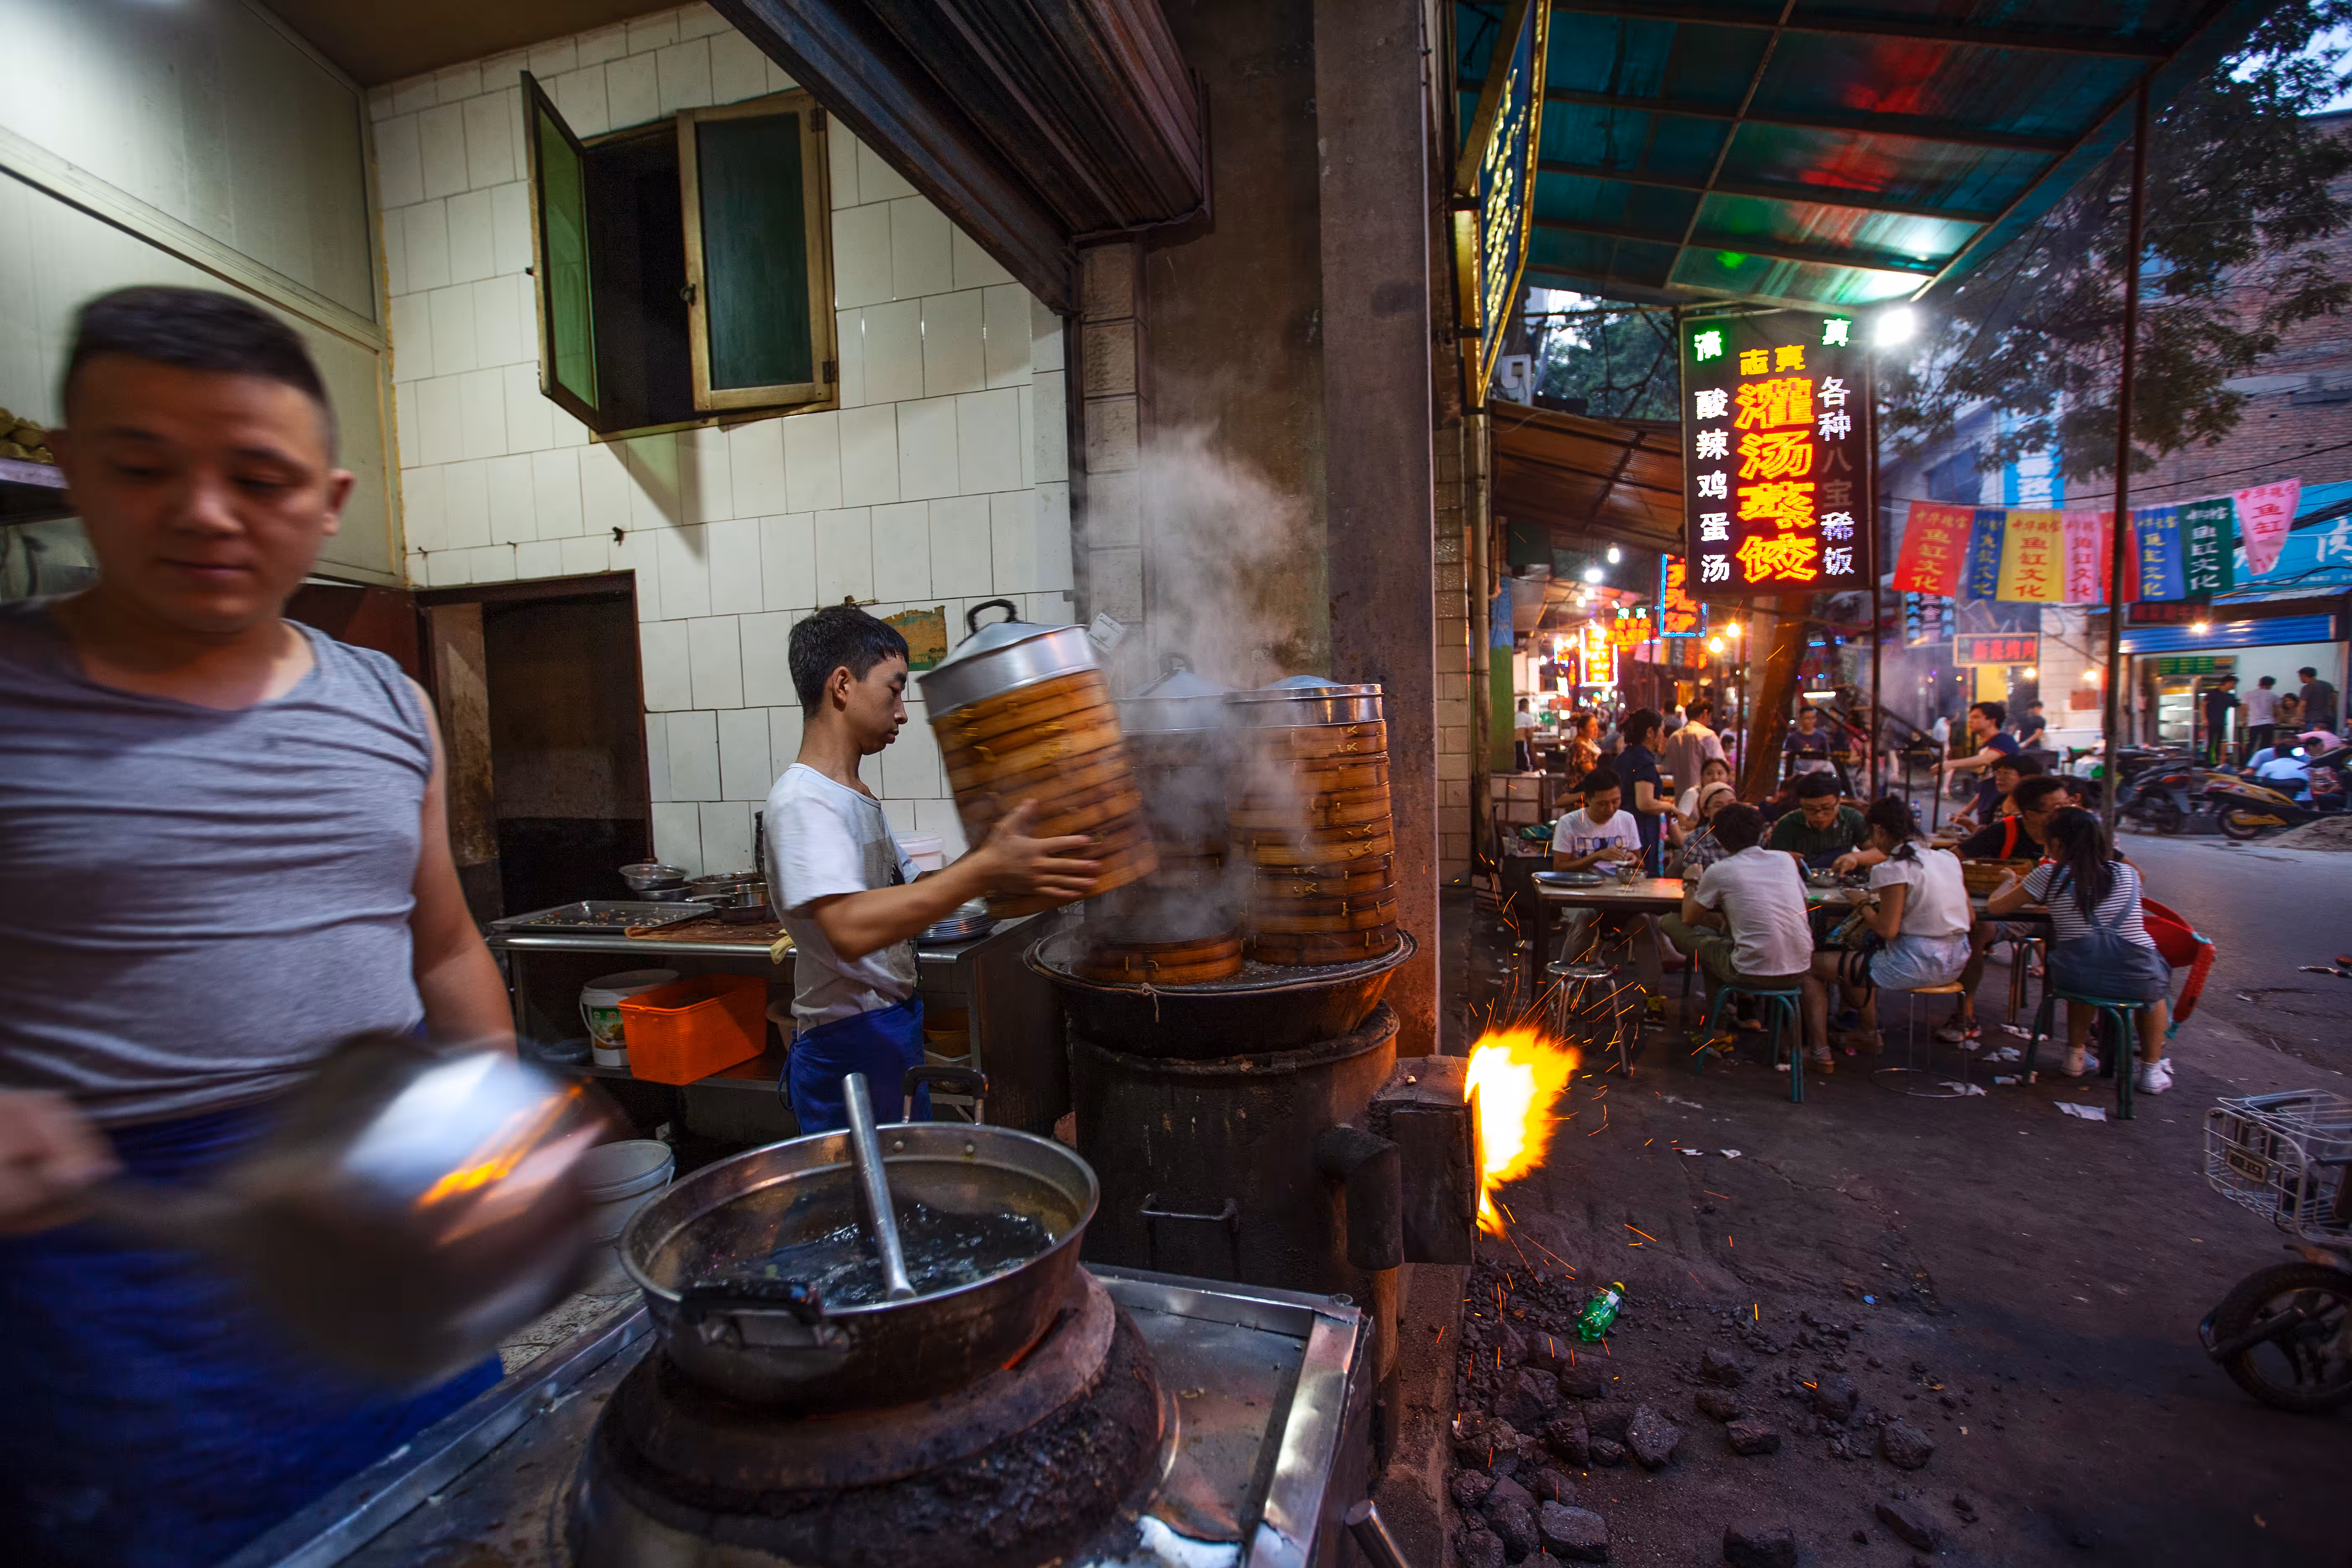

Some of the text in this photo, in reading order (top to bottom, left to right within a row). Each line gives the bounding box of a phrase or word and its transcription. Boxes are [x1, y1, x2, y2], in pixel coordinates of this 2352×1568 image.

[1694, 388, 1729, 583] 酸辣鸡蛋汤
[1734, 377, 1817, 583] 灌汤蒸饺
[1818, 376, 1855, 575] 各种八宝稀饭
